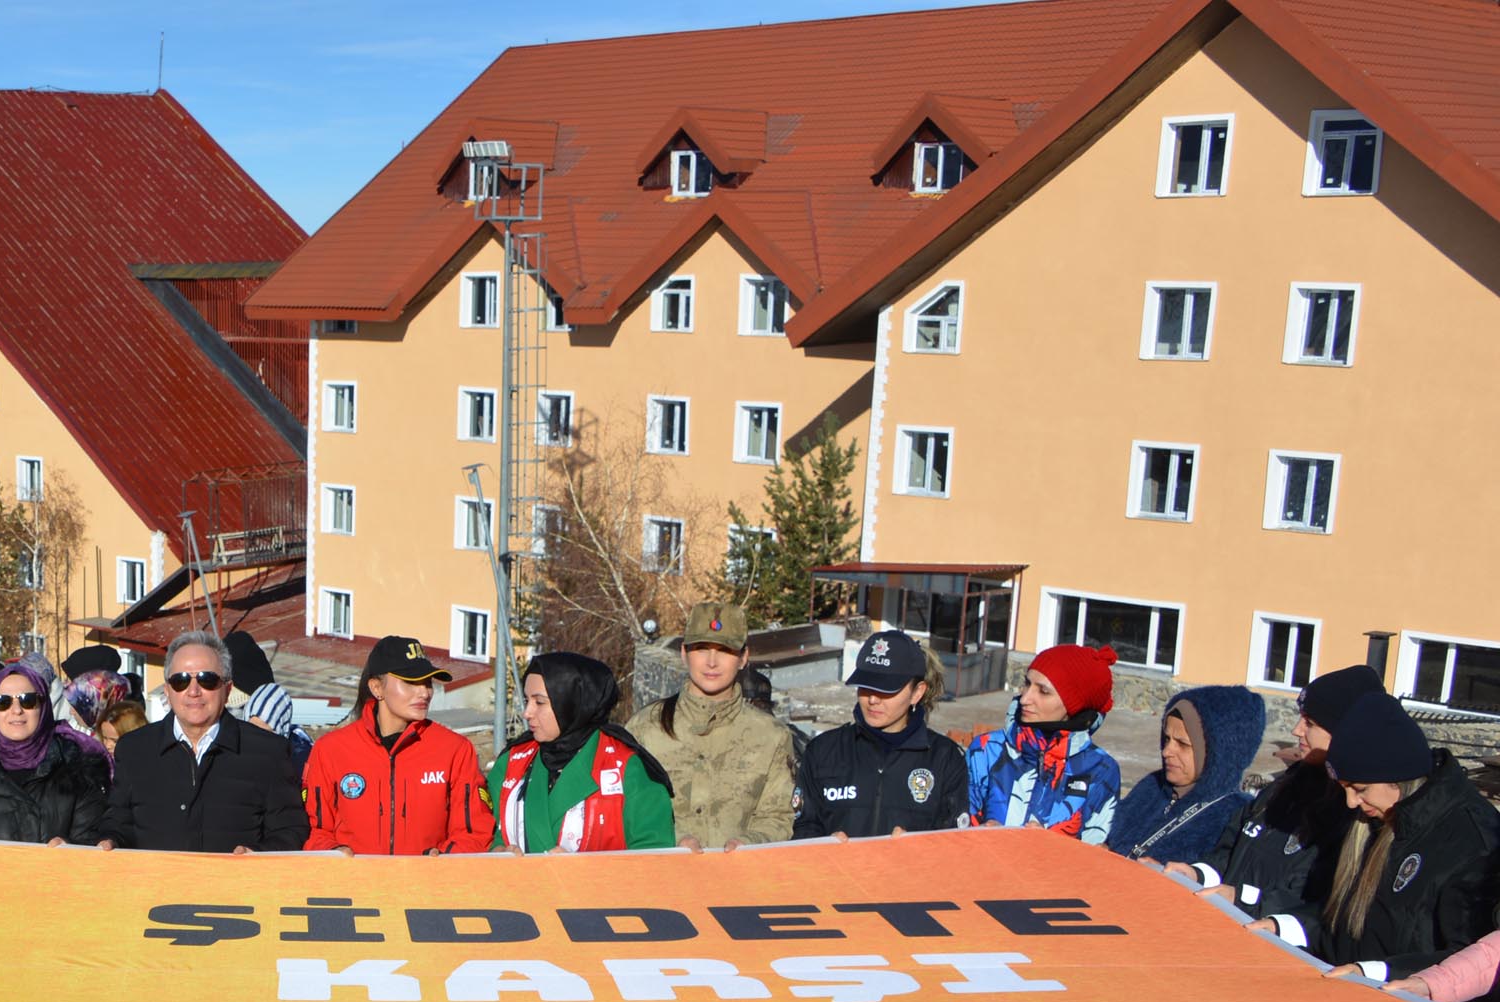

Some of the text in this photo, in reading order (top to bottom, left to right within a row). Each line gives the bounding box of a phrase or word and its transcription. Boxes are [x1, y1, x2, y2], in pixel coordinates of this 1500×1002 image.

[406, 643, 425, 660] JA
[421, 771, 445, 784] JAK
[143, 897, 1128, 946] ŞİDDETE
[276, 952, 1067, 1002] KARŞI
